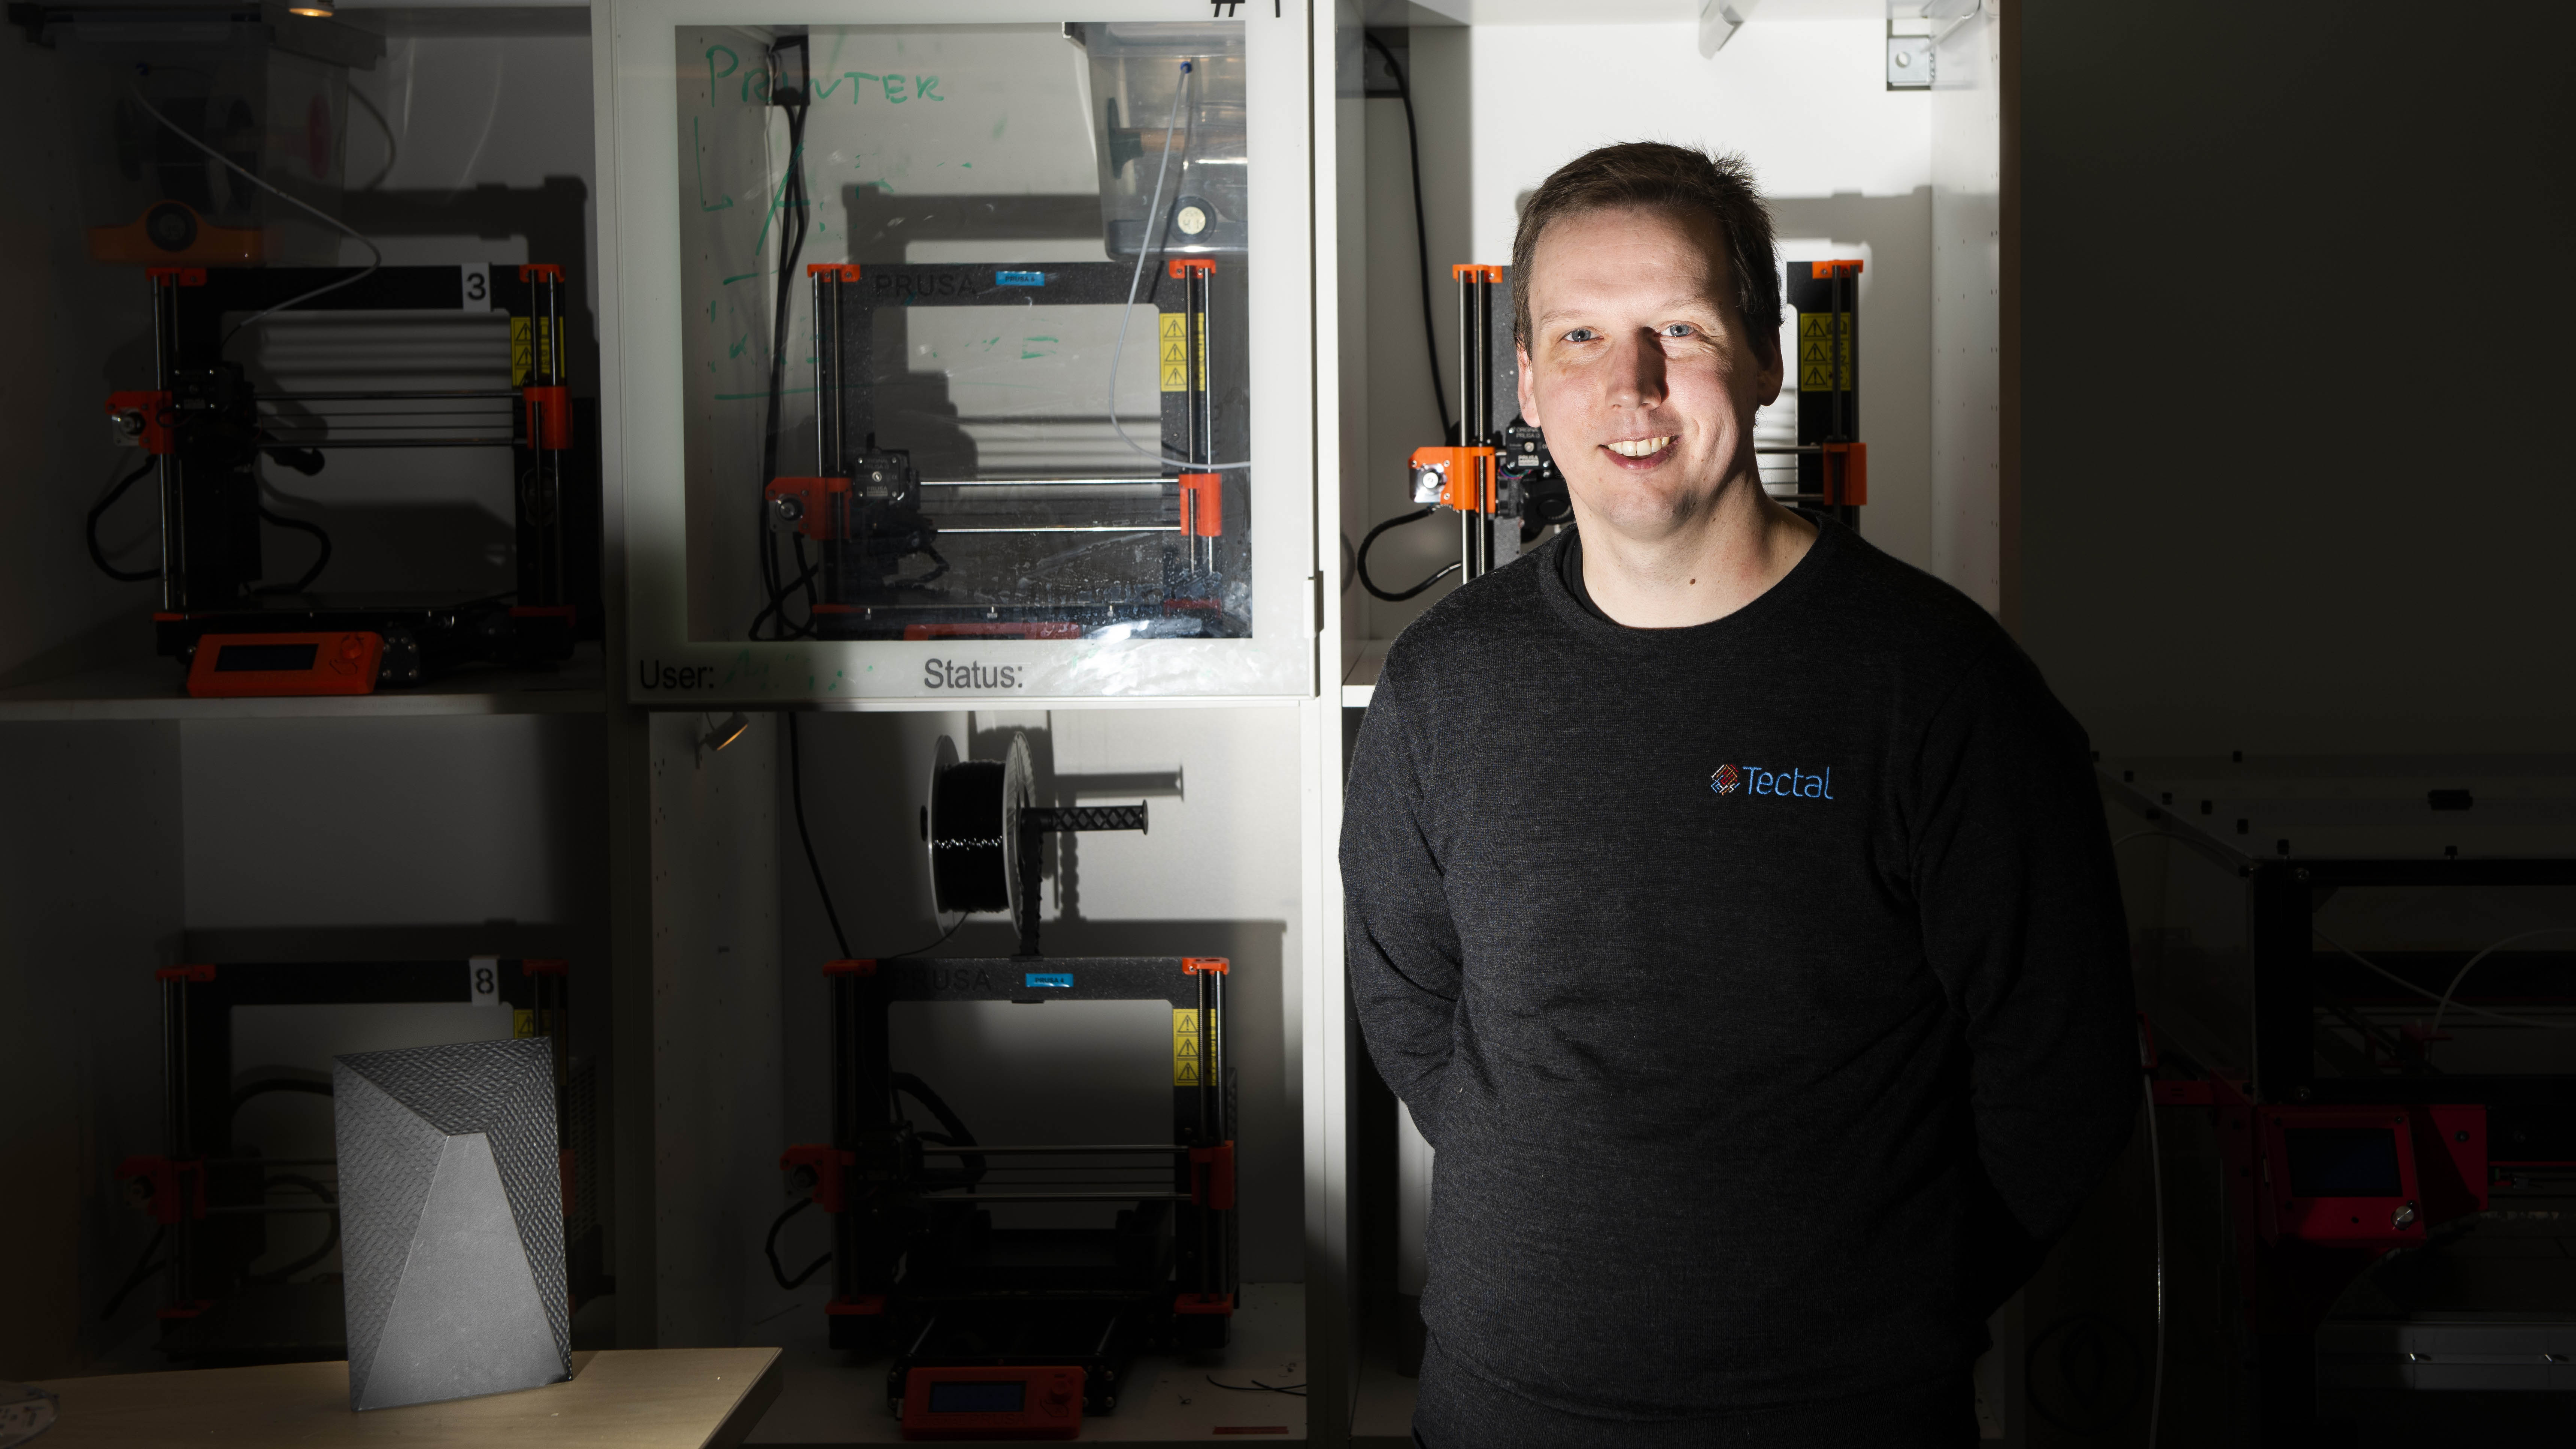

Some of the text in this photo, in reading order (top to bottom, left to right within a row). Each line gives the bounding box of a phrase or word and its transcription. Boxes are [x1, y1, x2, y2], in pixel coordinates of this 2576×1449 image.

[466, 272, 487, 301] 3
[876, 273, 977, 297] PRUSA
[640, 660, 714, 689] User:
[924, 658, 1022, 689] Status:
[1742, 766, 1833, 799] Tectal
[475, 967, 495, 995] 8
[894, 968, 992, 992] PRUSA
[913, 1413, 1026, 1426] ORIGINAL PRUSA
